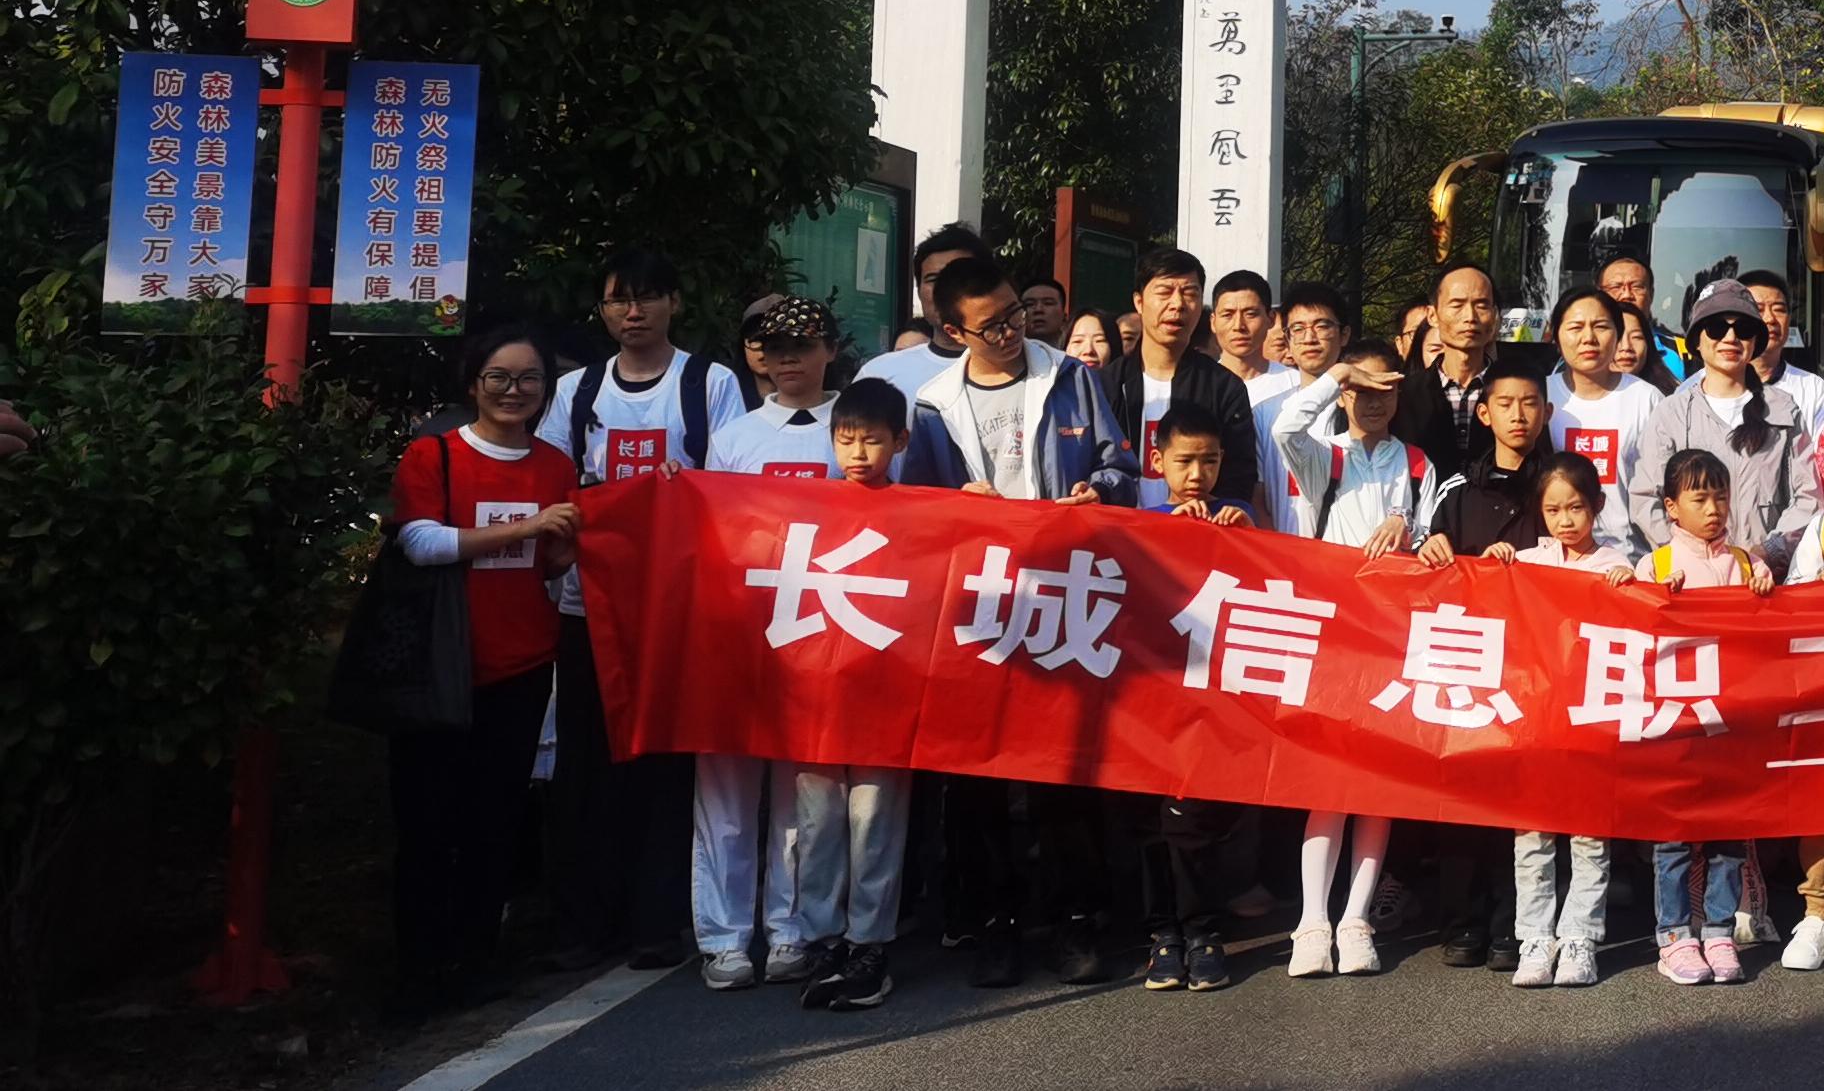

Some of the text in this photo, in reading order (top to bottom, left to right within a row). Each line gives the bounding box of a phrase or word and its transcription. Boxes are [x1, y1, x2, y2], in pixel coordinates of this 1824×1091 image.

[138, 68, 187, 299] 防火安全守万家
[185, 70, 234, 301] 森林美景靠大家
[363, 77, 407, 302] 森林防火有保障
[408, 78, 452, 302] 无火祭祖要提倡
[618, 438, 655, 458] 长城
[1574, 435, 1609, 452] 长城
